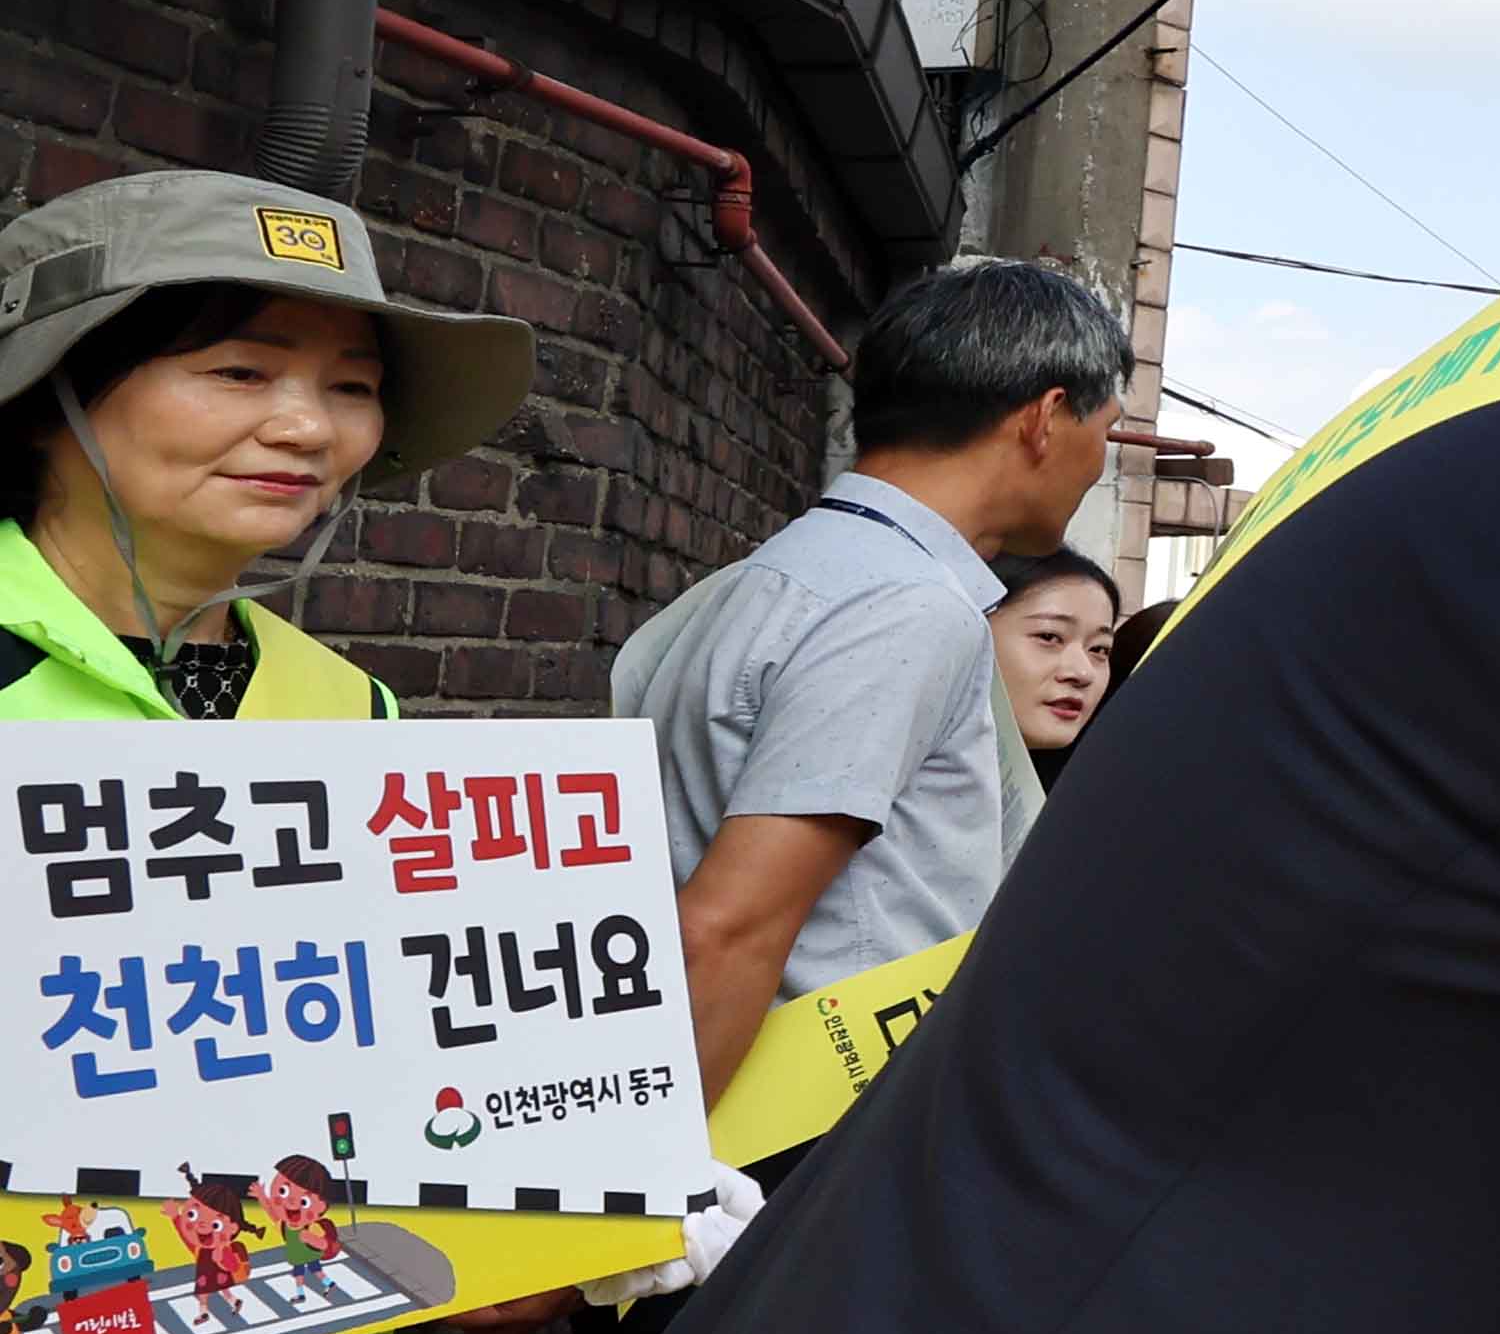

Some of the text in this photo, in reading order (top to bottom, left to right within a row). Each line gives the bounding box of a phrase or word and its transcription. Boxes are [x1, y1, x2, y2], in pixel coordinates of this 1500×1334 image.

[16, 770, 632, 918] 멈추고 살피고
[39, 913, 664, 1099] 천천히 건너요
[485, 1065, 675, 1131] 인천광역시 동구
